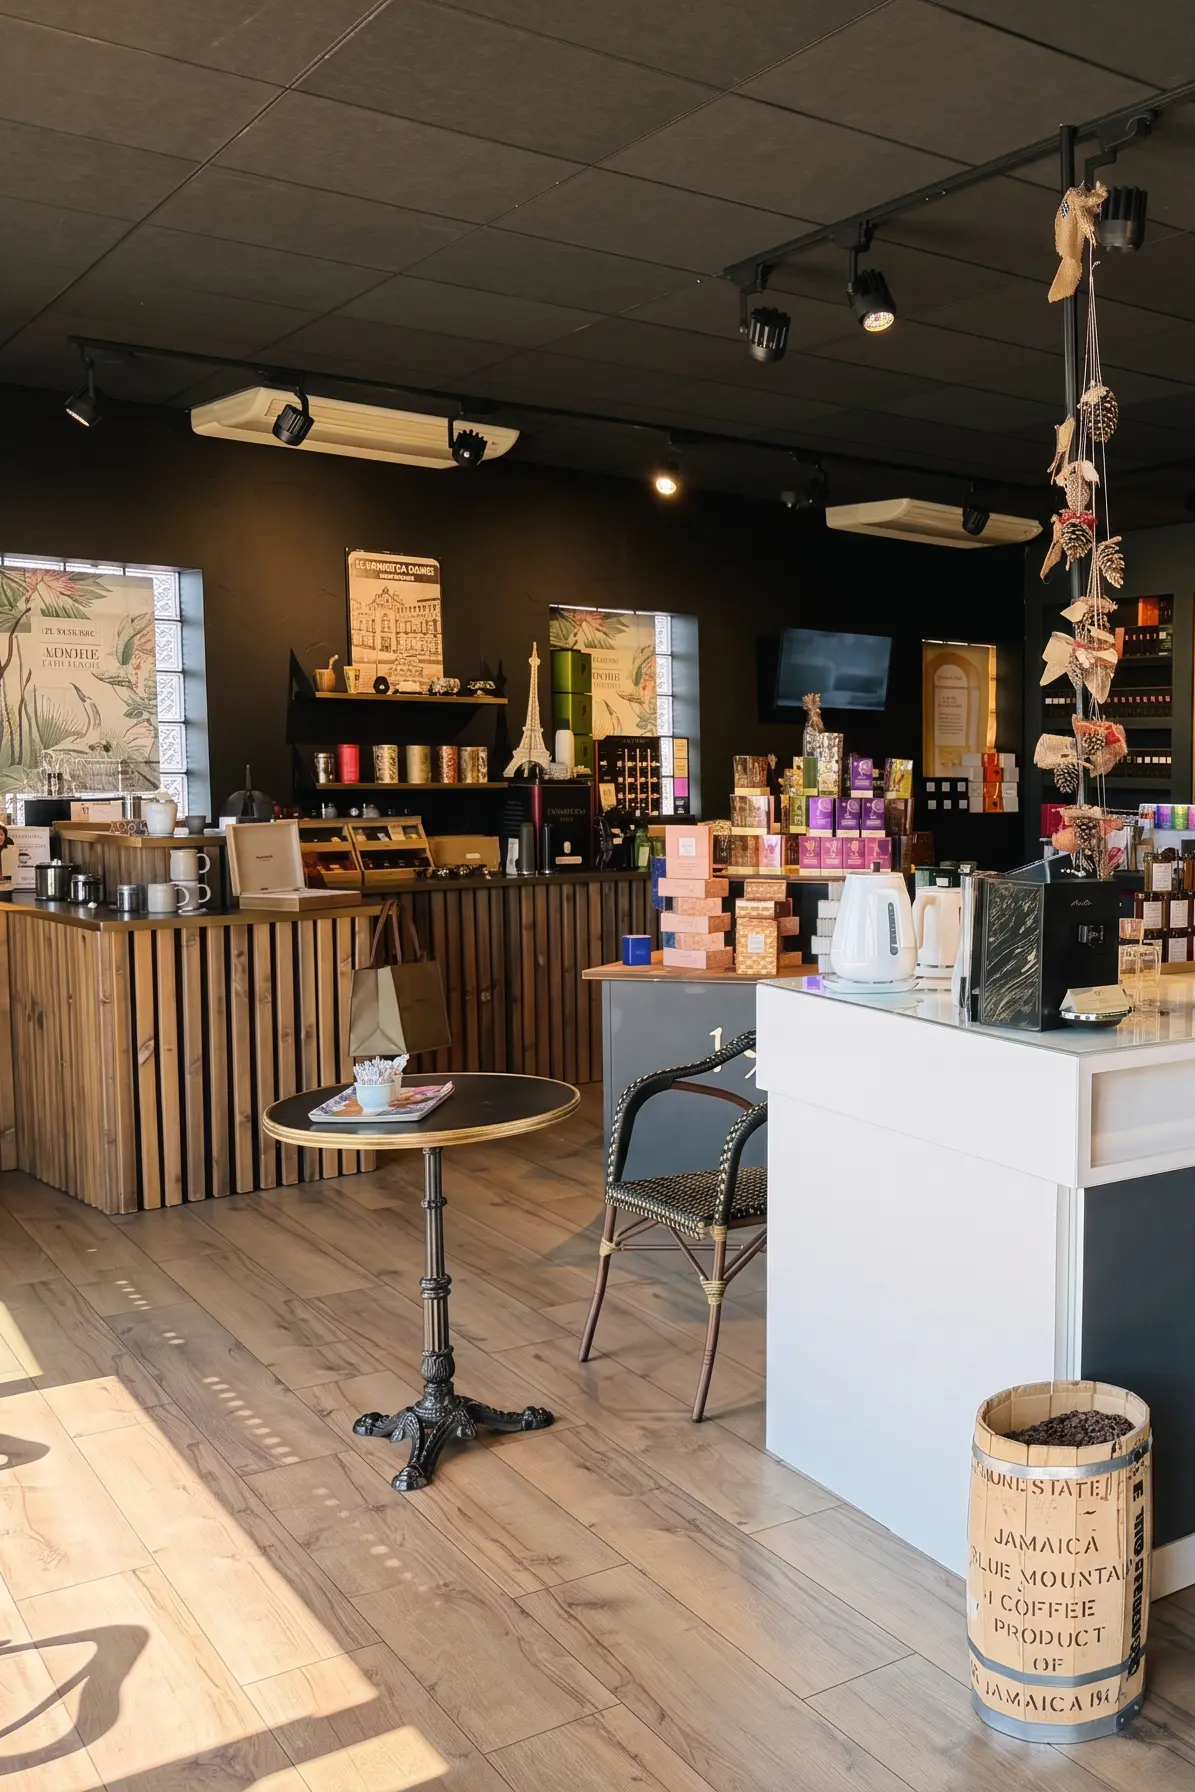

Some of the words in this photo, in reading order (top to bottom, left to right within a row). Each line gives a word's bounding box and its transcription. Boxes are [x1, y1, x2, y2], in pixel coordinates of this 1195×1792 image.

[994, 1528, 1099, 1555] JAMAICA
[1000, 1594, 1096, 1619] COFFEE
[994, 1617, 1106, 1648] PRODUCT
[1033, 1657, 1064, 1672] OF
[985, 1680, 1083, 1713] JAMAICA
